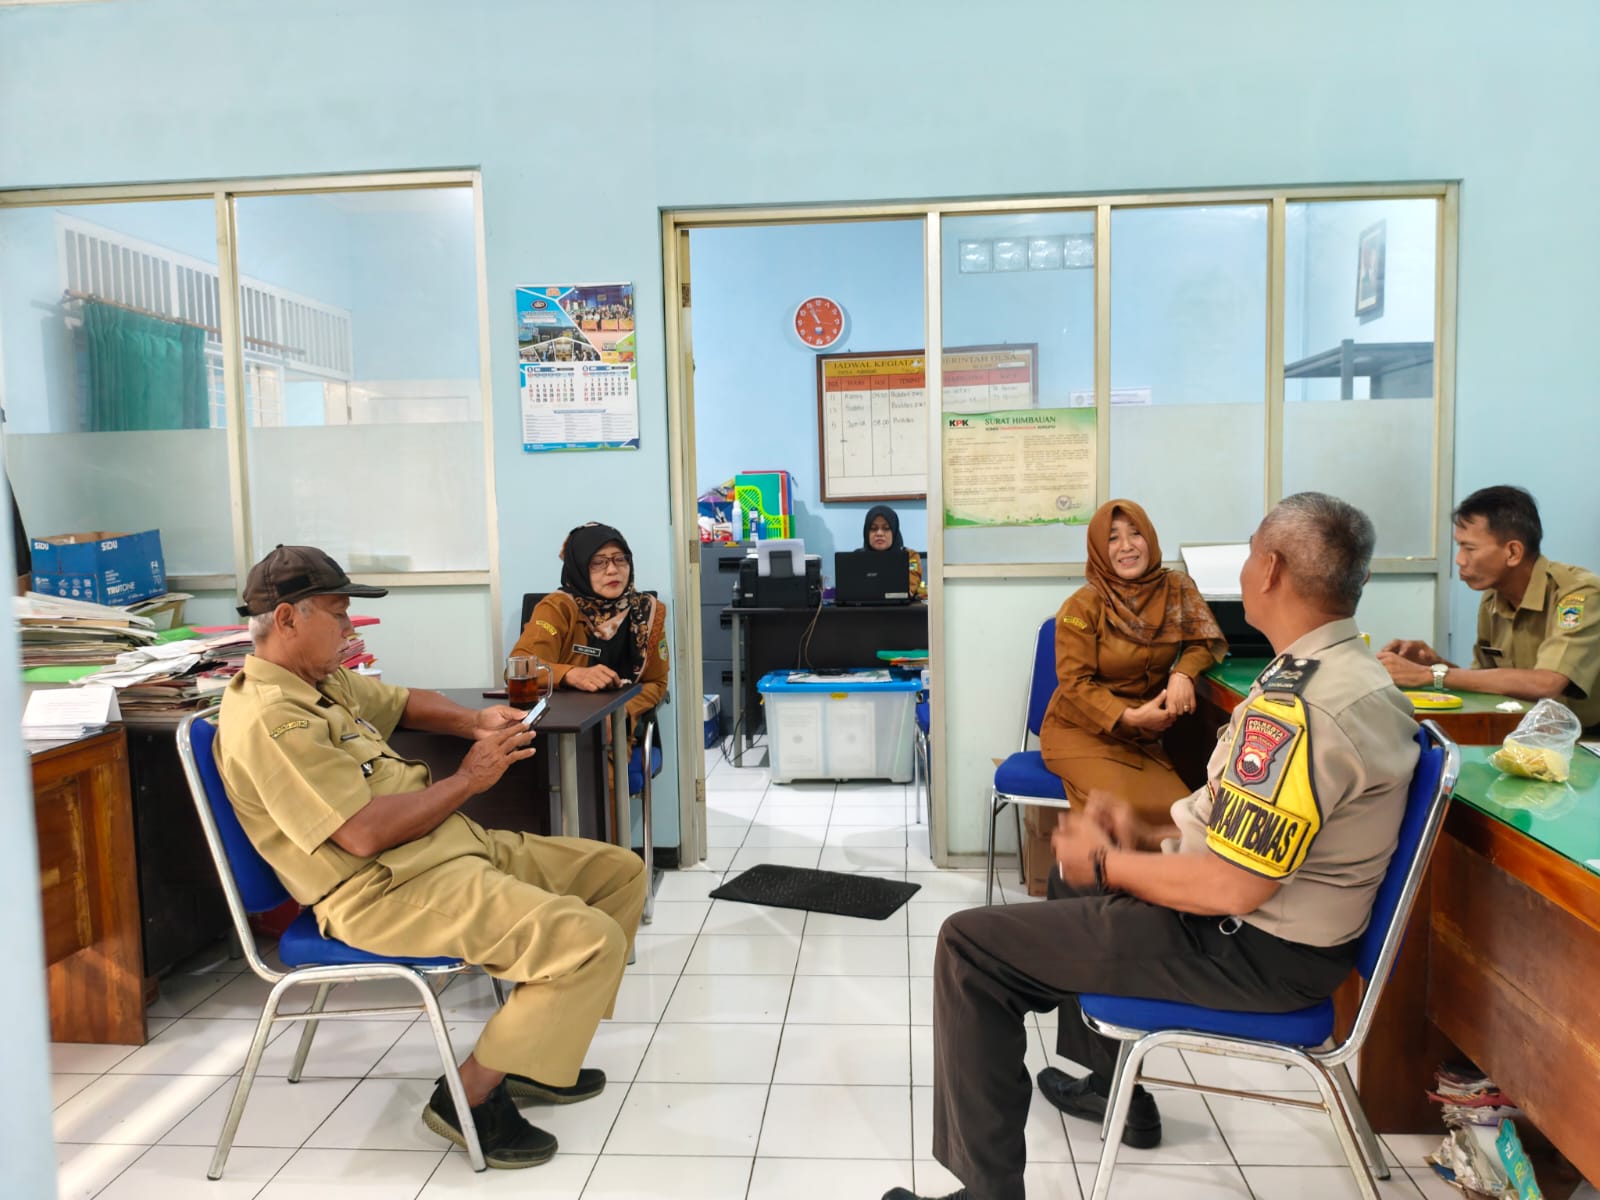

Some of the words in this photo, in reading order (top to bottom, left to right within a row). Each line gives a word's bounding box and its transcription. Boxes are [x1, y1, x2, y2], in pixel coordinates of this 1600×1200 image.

[833, 361, 872, 369] JADWAL
[949, 419, 969, 427] KPK
[985, 417, 1010, 426] SURAT
[1012, 415, 1056, 425] HIMBAUAN
